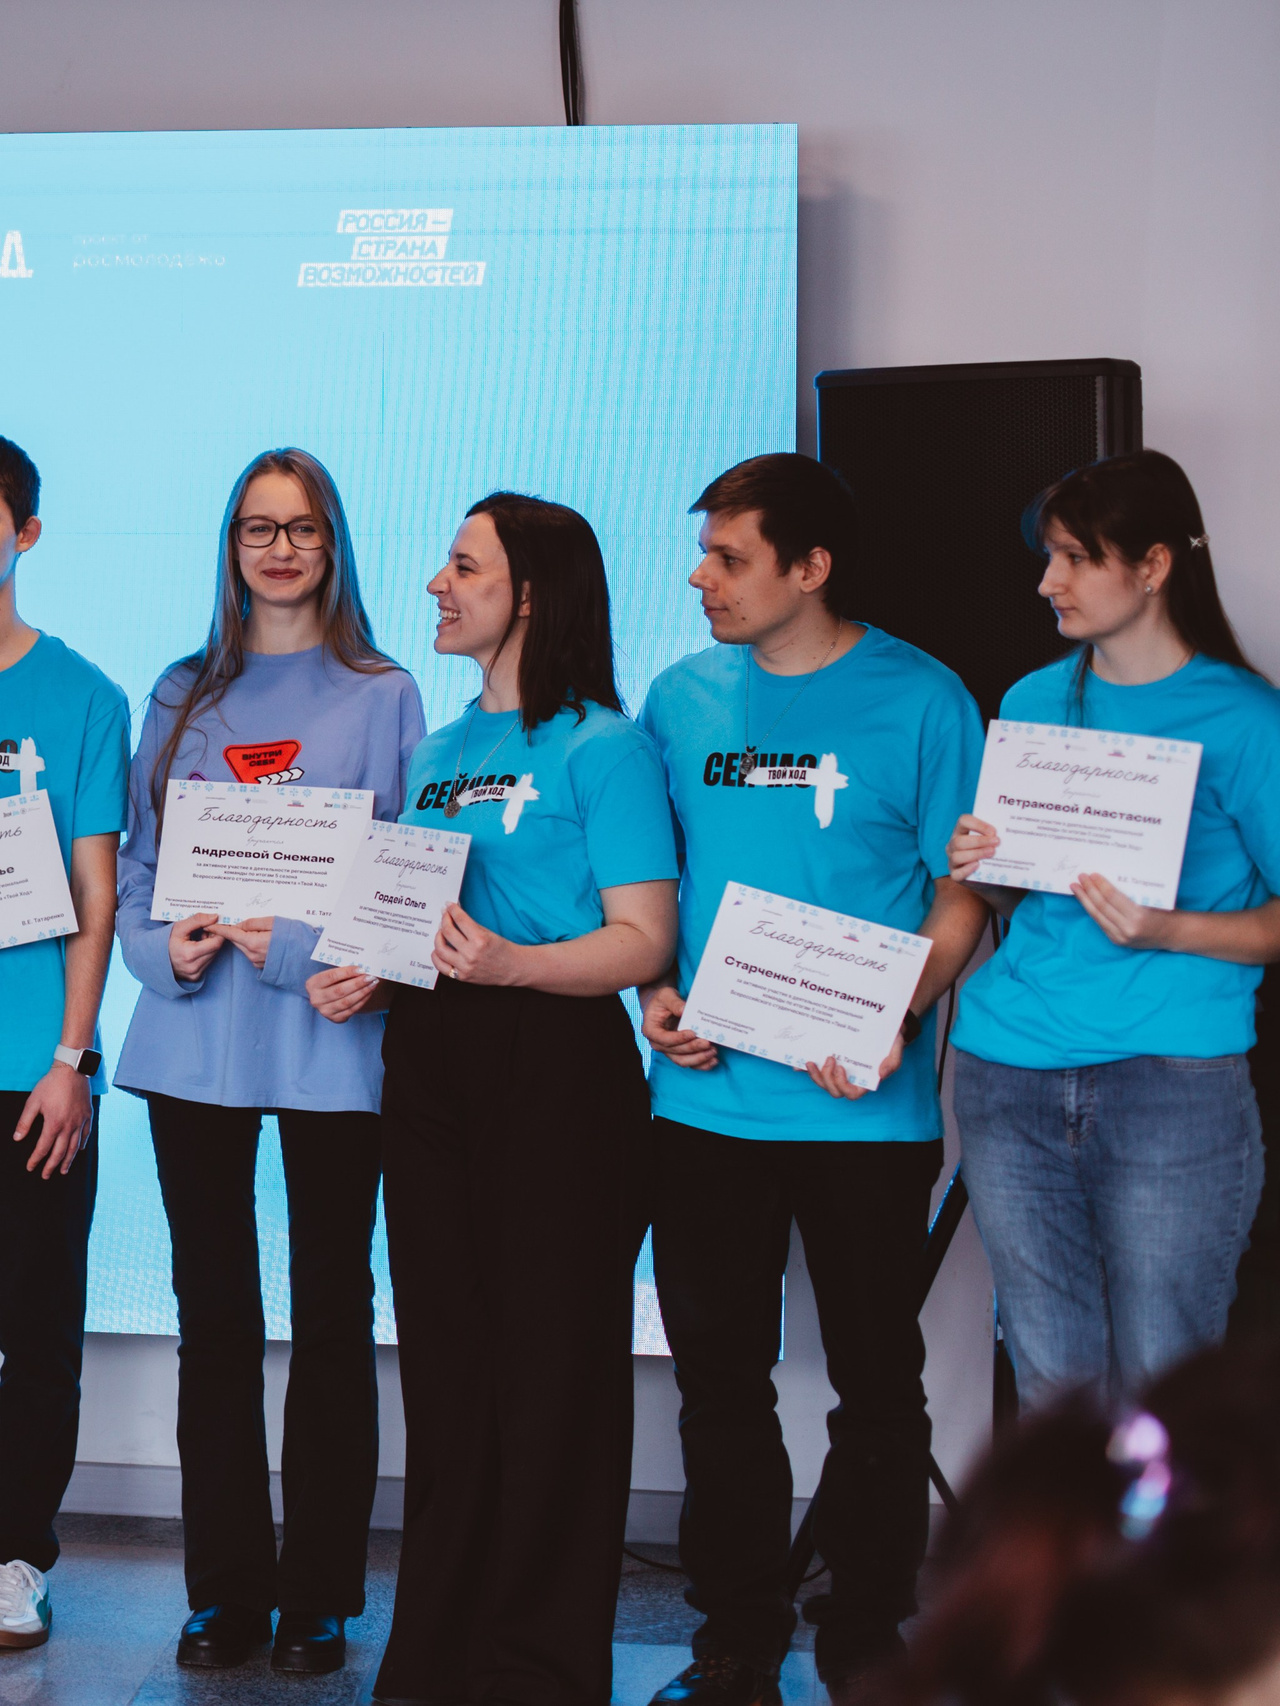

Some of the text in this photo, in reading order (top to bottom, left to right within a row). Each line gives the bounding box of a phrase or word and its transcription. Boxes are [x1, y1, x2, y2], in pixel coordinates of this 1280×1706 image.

[343, 213, 428, 231] РОССИЯ
[358, 239, 438, 258] СТРАНА
[303, 264, 478, 284] ВОЗМОЖНОСТЕЙ
[242, 749, 282, 761] ВНУТРИ
[249, 758, 276, 767] СЕБЯ
[768, 766, 807, 781] ТВОЙ ХОД
[1016, 752, 1158, 784] Благодарность
[487, 786, 505, 798] ХОД
[998, 795, 1161, 824] Петраковой Анастасии
[198, 806, 337, 833] Благодарность
[192, 846, 334, 864] Андреевой Снежане
[374, 848, 447, 878] Благодарность
[374, 891, 426, 910] Гордей Ольге
[34, 913, 65, 923] Татаренко
[750, 920, 887, 972] Благодарность
[724, 956, 885, 1013] Старченко Константину
